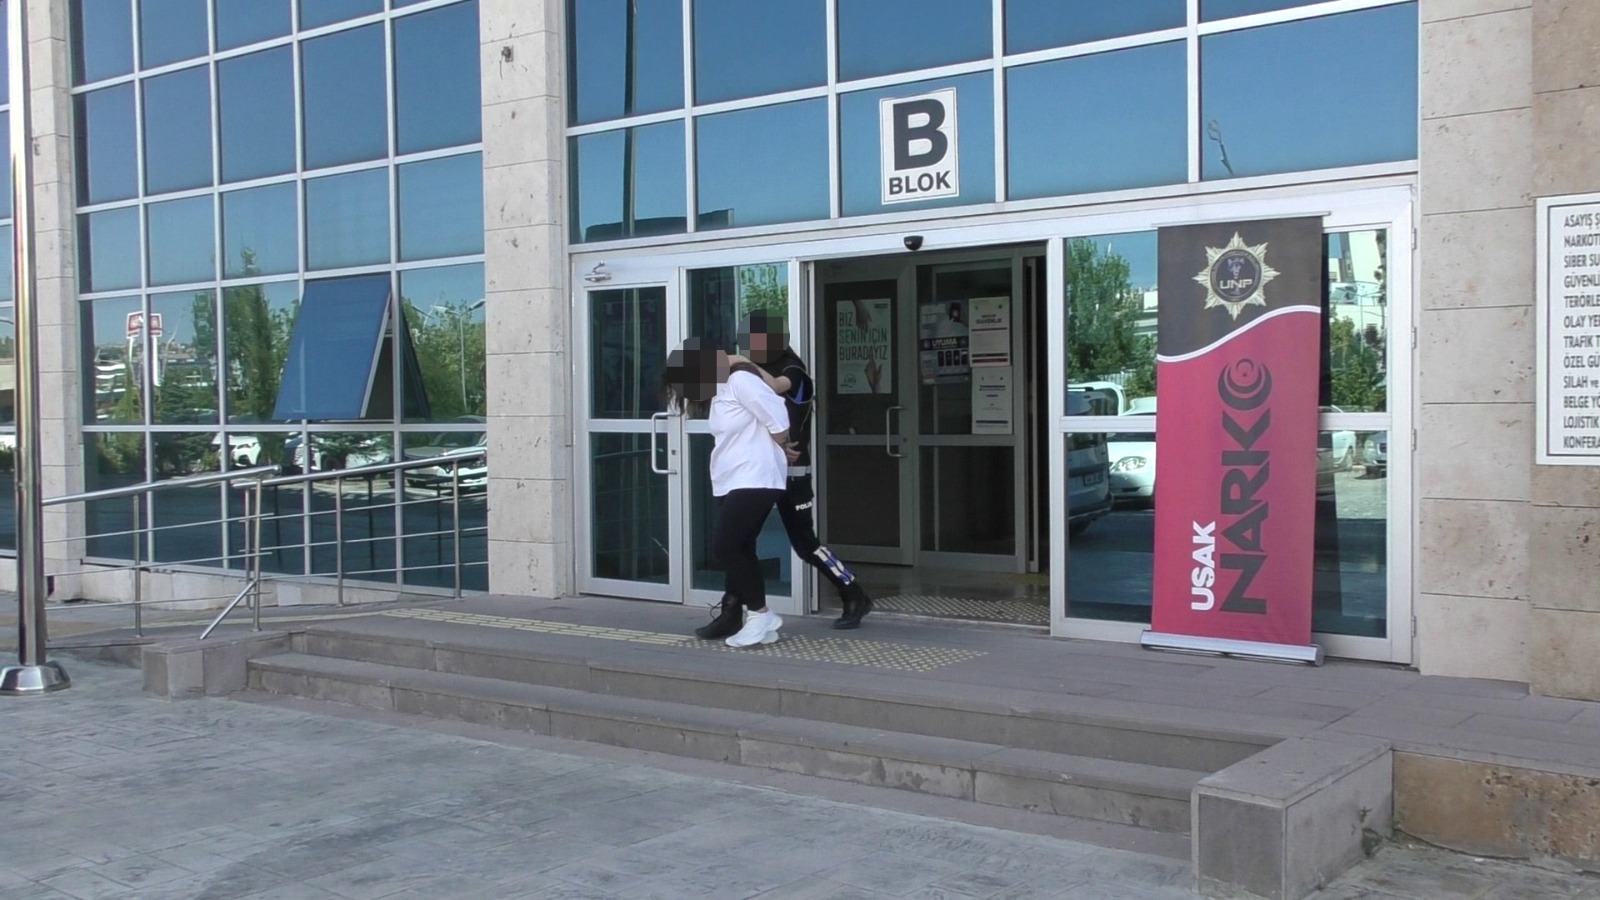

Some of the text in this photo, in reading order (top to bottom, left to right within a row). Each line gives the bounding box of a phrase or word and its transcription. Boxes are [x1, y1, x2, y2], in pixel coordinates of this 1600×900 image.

[893, 98, 948, 171] B
[889, 170, 952, 195] BLOK
[1564, 314, 1586, 328] OLAY
[1564, 352, 1586, 368] ÖZEL
[1564, 395, 1589, 408] BELGE
